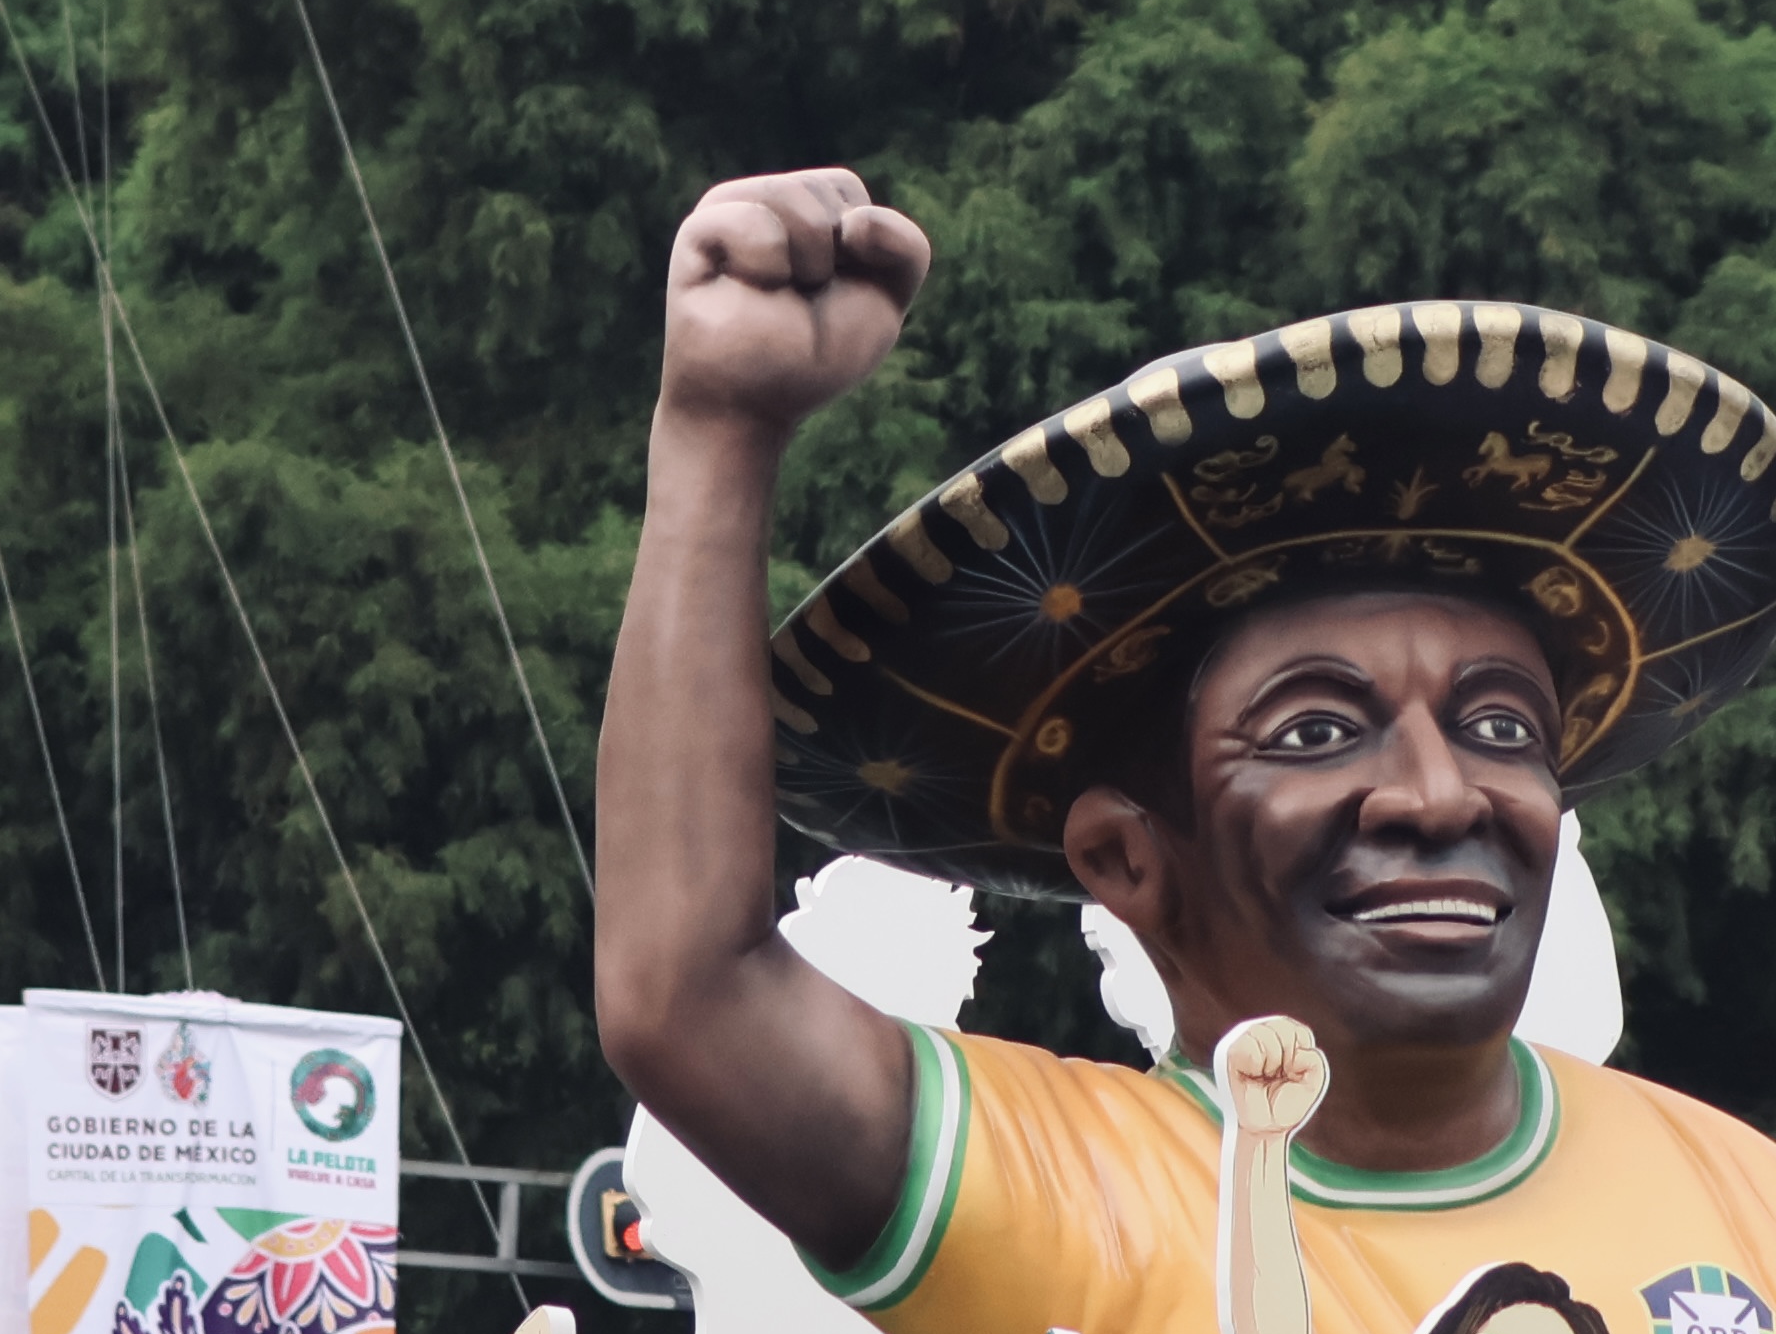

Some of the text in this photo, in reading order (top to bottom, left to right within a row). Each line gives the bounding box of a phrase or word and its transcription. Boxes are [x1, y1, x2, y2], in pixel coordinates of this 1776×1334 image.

[47, 1116, 255, 1137] GOBIERNO DE LA
[47, 1141, 257, 1164] CIUDAD DE MÉXICO
[287, 1147, 377, 1174] LA PELOTA
[47, 1169, 96, 1182] CAPITAL
[100, 1170, 117, 1183] DE
[121, 1171, 137, 1183] LA
